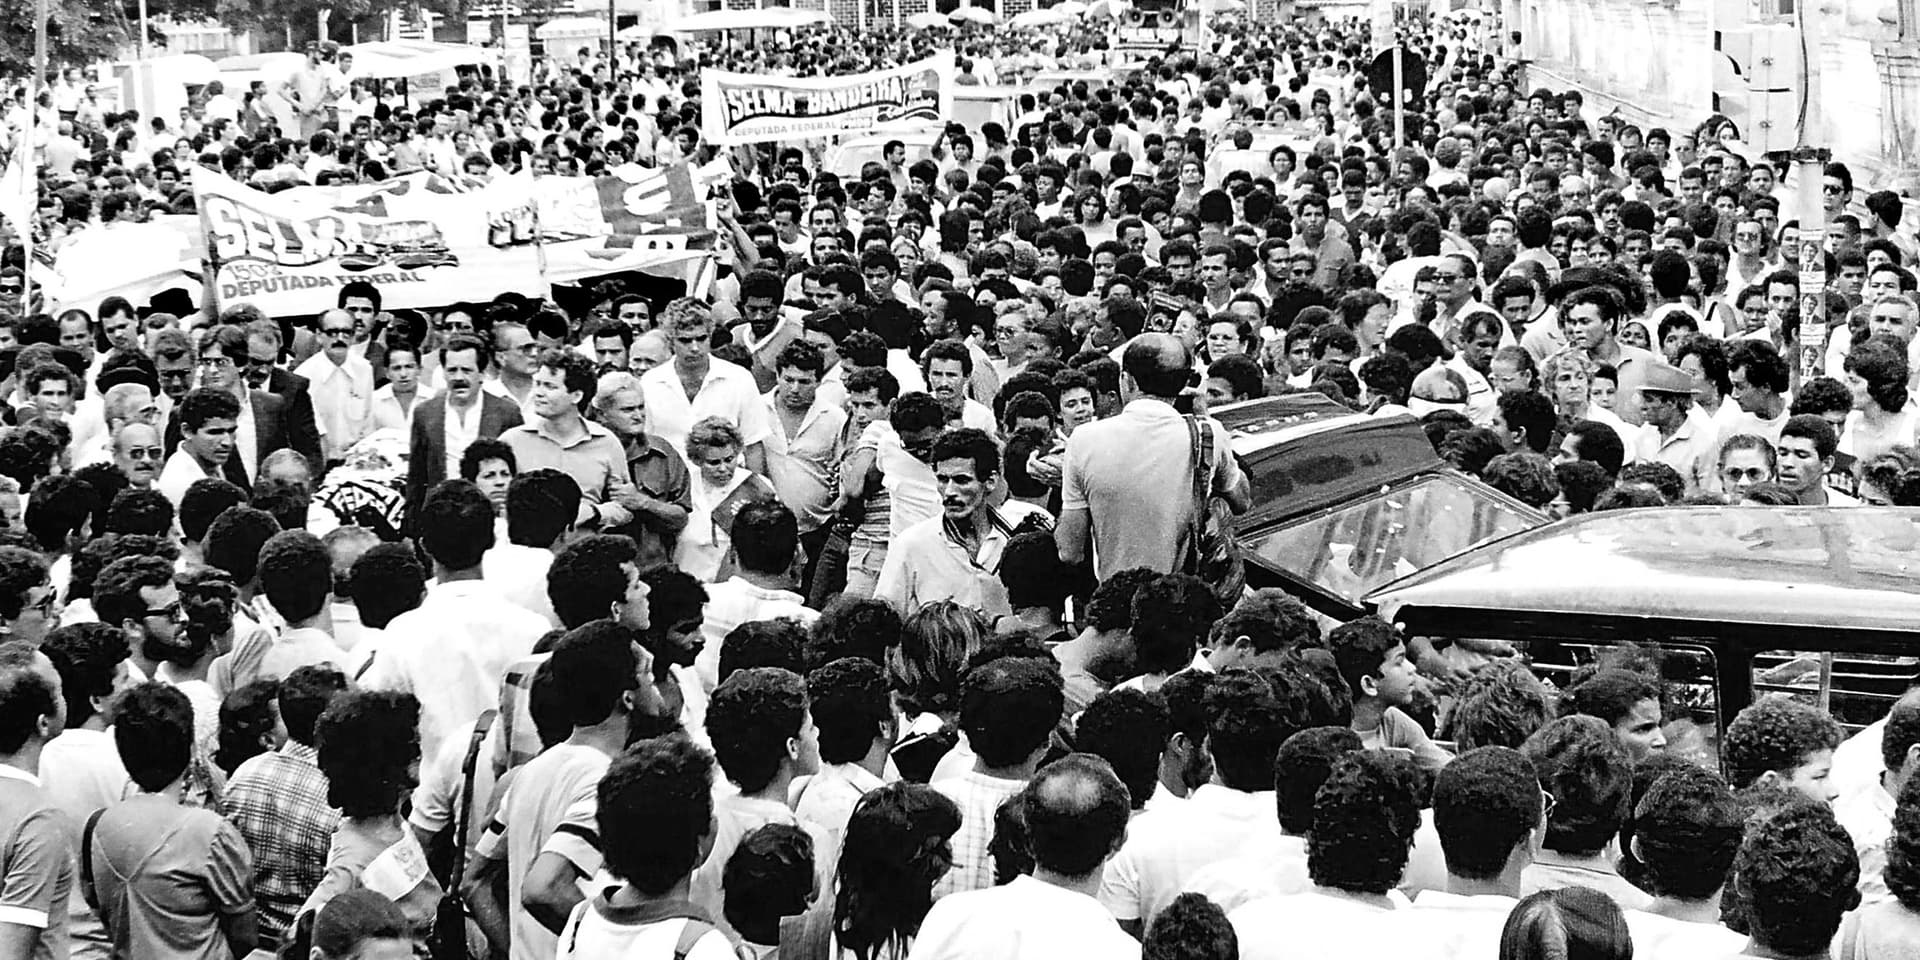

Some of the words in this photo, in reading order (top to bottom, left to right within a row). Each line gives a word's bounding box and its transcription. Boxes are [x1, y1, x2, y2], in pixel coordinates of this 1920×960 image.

[727, 88, 796, 121] SELMA
[807, 77, 902, 115] BANDEIRA
[735, 124, 788, 136] DEPUTADA
[791, 120, 837, 132] FEDERAL
[222, 275, 334, 299] DEPUTADA
[336, 270, 427, 285] FEDERAL
